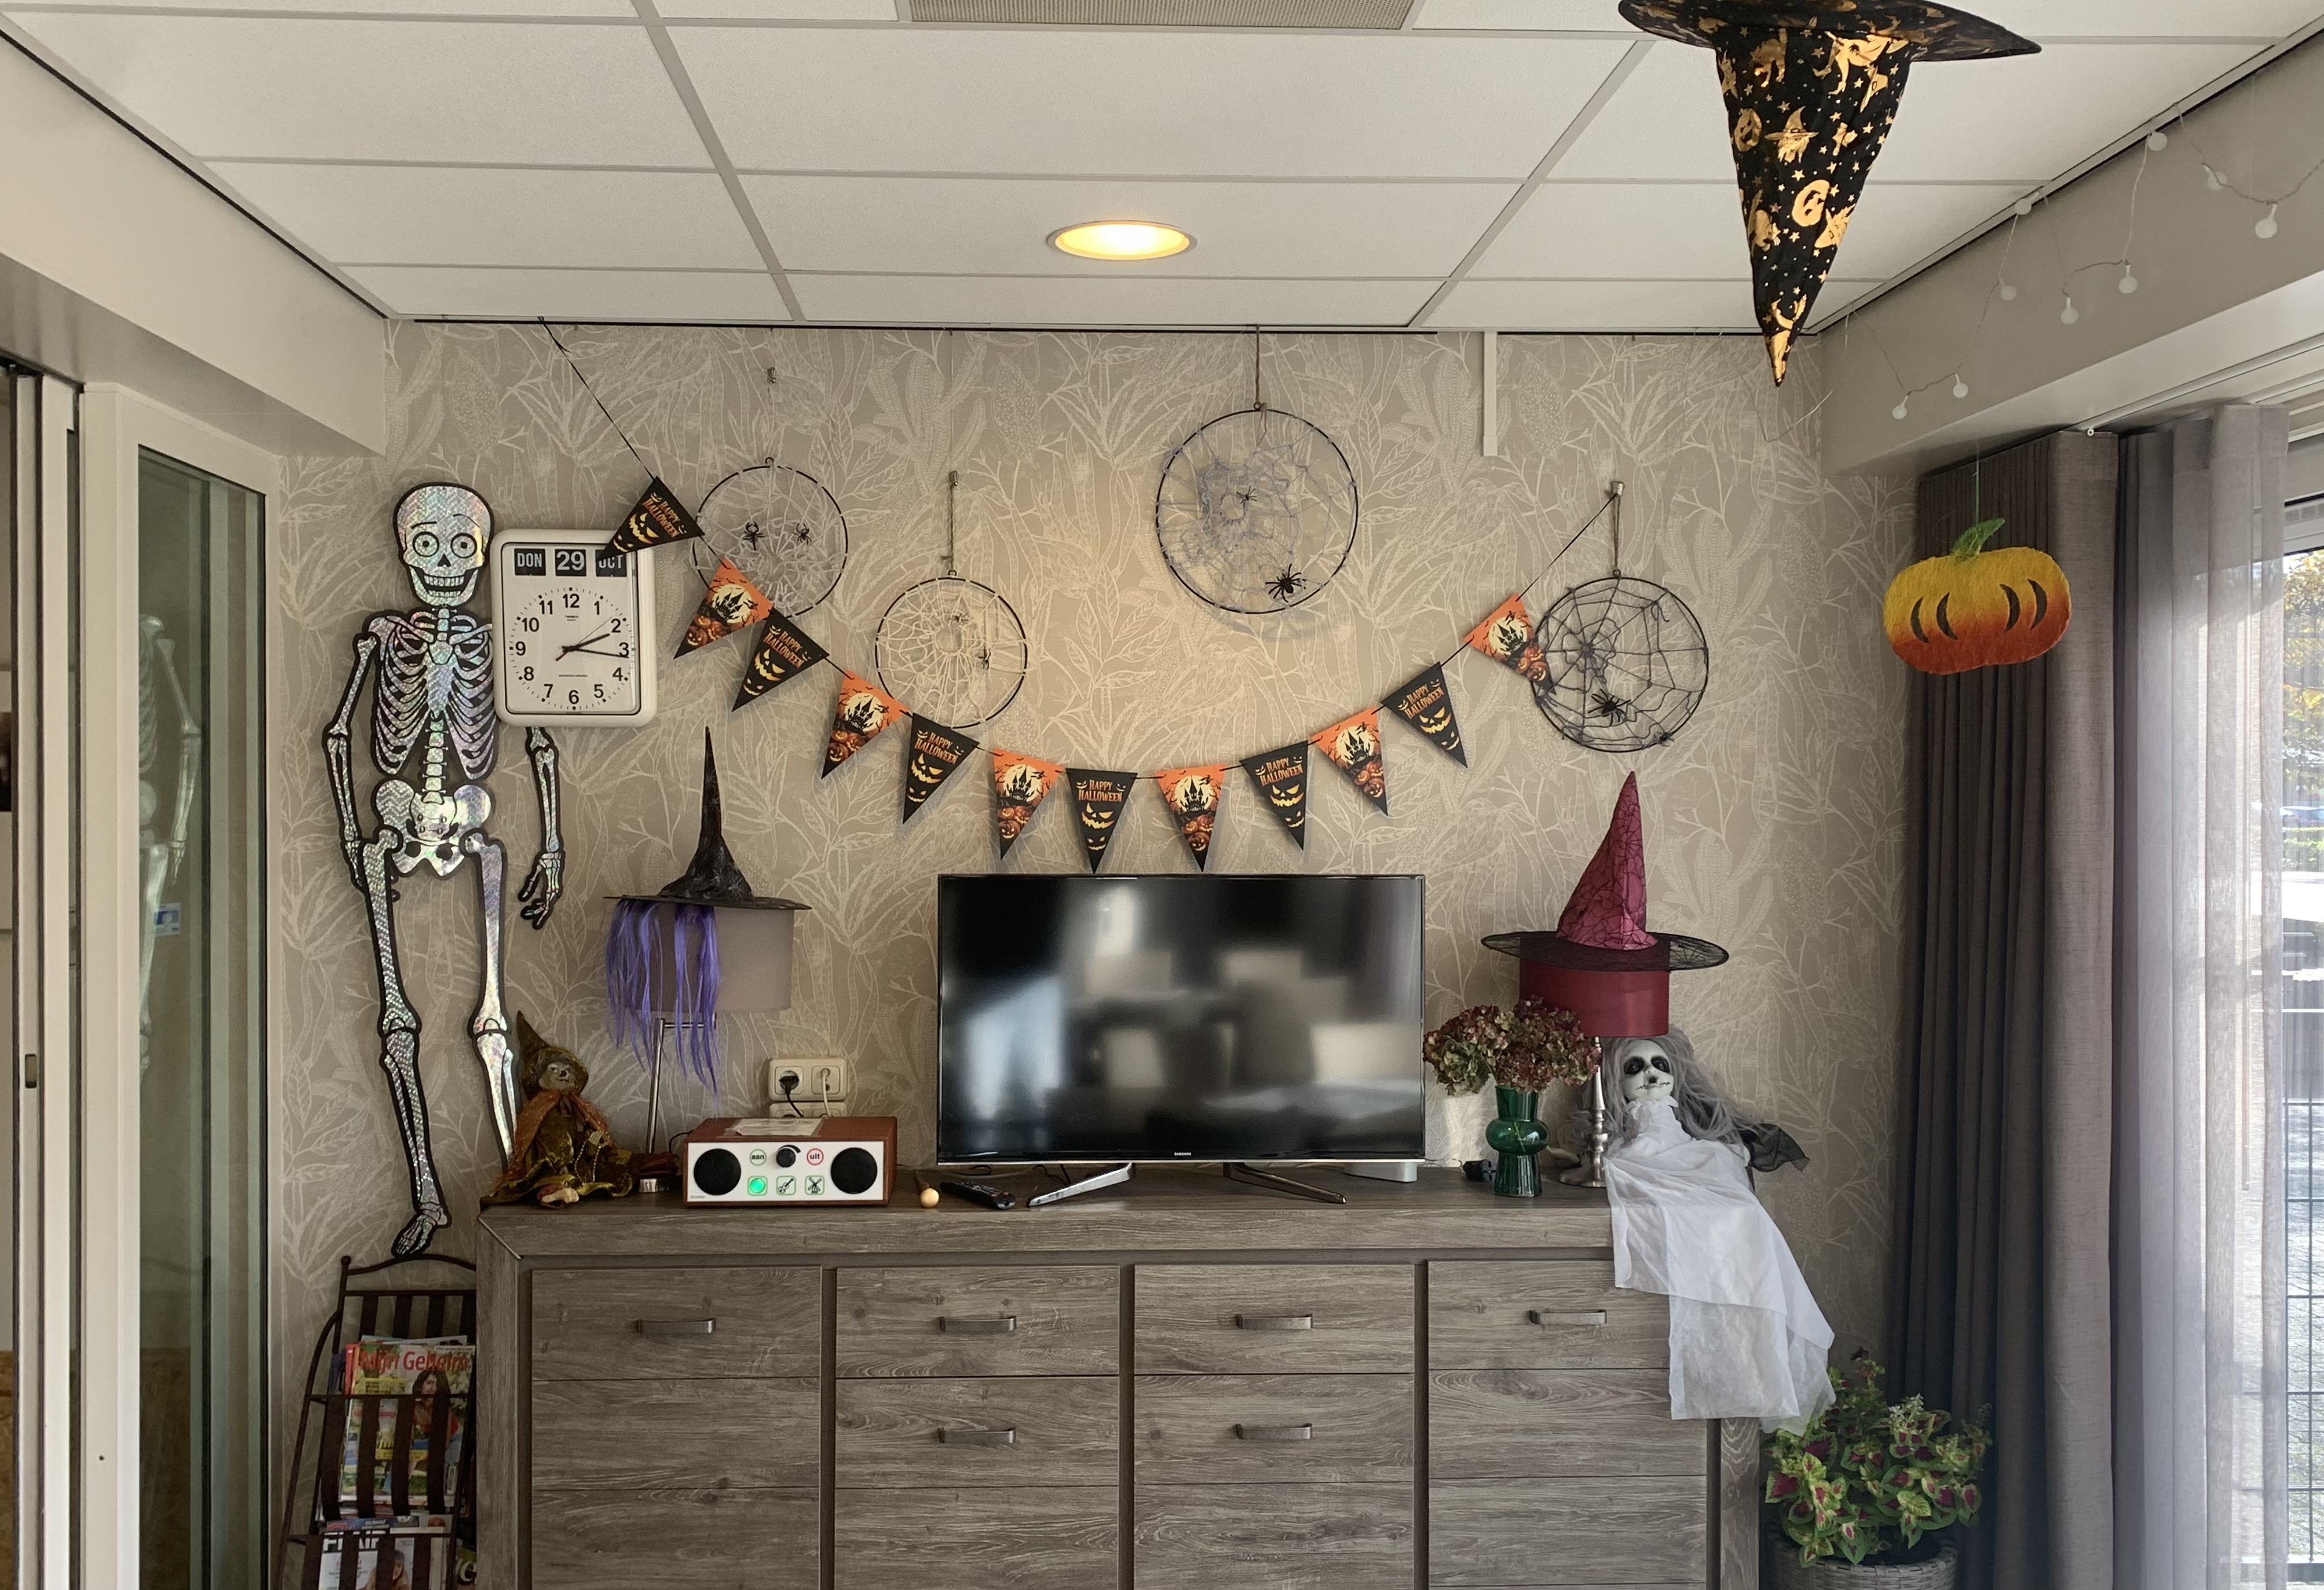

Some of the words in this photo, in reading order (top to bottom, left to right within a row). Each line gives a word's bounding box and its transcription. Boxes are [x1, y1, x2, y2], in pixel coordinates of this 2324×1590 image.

[642, 498, 680, 538] HALLOWEEN
[658, 500, 680, 523] HAPPY
[517, 553, 542, 568] DON
[556, 551, 585, 571] 29
[599, 555, 623, 568] OCT
[539, 600, 553, 615] 11
[563, 593, 580, 608] 12
[594, 600, 600, 615] 1
[521, 617, 540, 632] 10
[611, 618, 621, 633] 2
[515, 641, 526, 656] 9
[779, 631, 803, 652] HAPPY
[618, 642, 629, 657] 3
[763, 632, 804, 669] HALLOWEEN
[523, 666, 534, 681] 8
[612, 667, 623, 681] 4
[544, 684, 553, 698] 7
[568, 689, 579, 704] 6
[594, 684, 604, 698] 5
[1406, 684, 1429, 704] HAPPY
[1404, 686, 1444, 719] HALLOWEEN
[928, 732, 953, 749] HAPPY
[914, 738, 959, 764] HALLOWEEN
[1266, 757, 1289, 773] HAPPY
[1259, 763, 1303, 786] HALLOWEEN
[1089, 779, 1113, 790] HAPPY
[1078, 789, 1123, 802] HALLOWEEN
[359, 1348, 400, 1374] Mijn
[403, 1350, 468, 1372] Geheim
